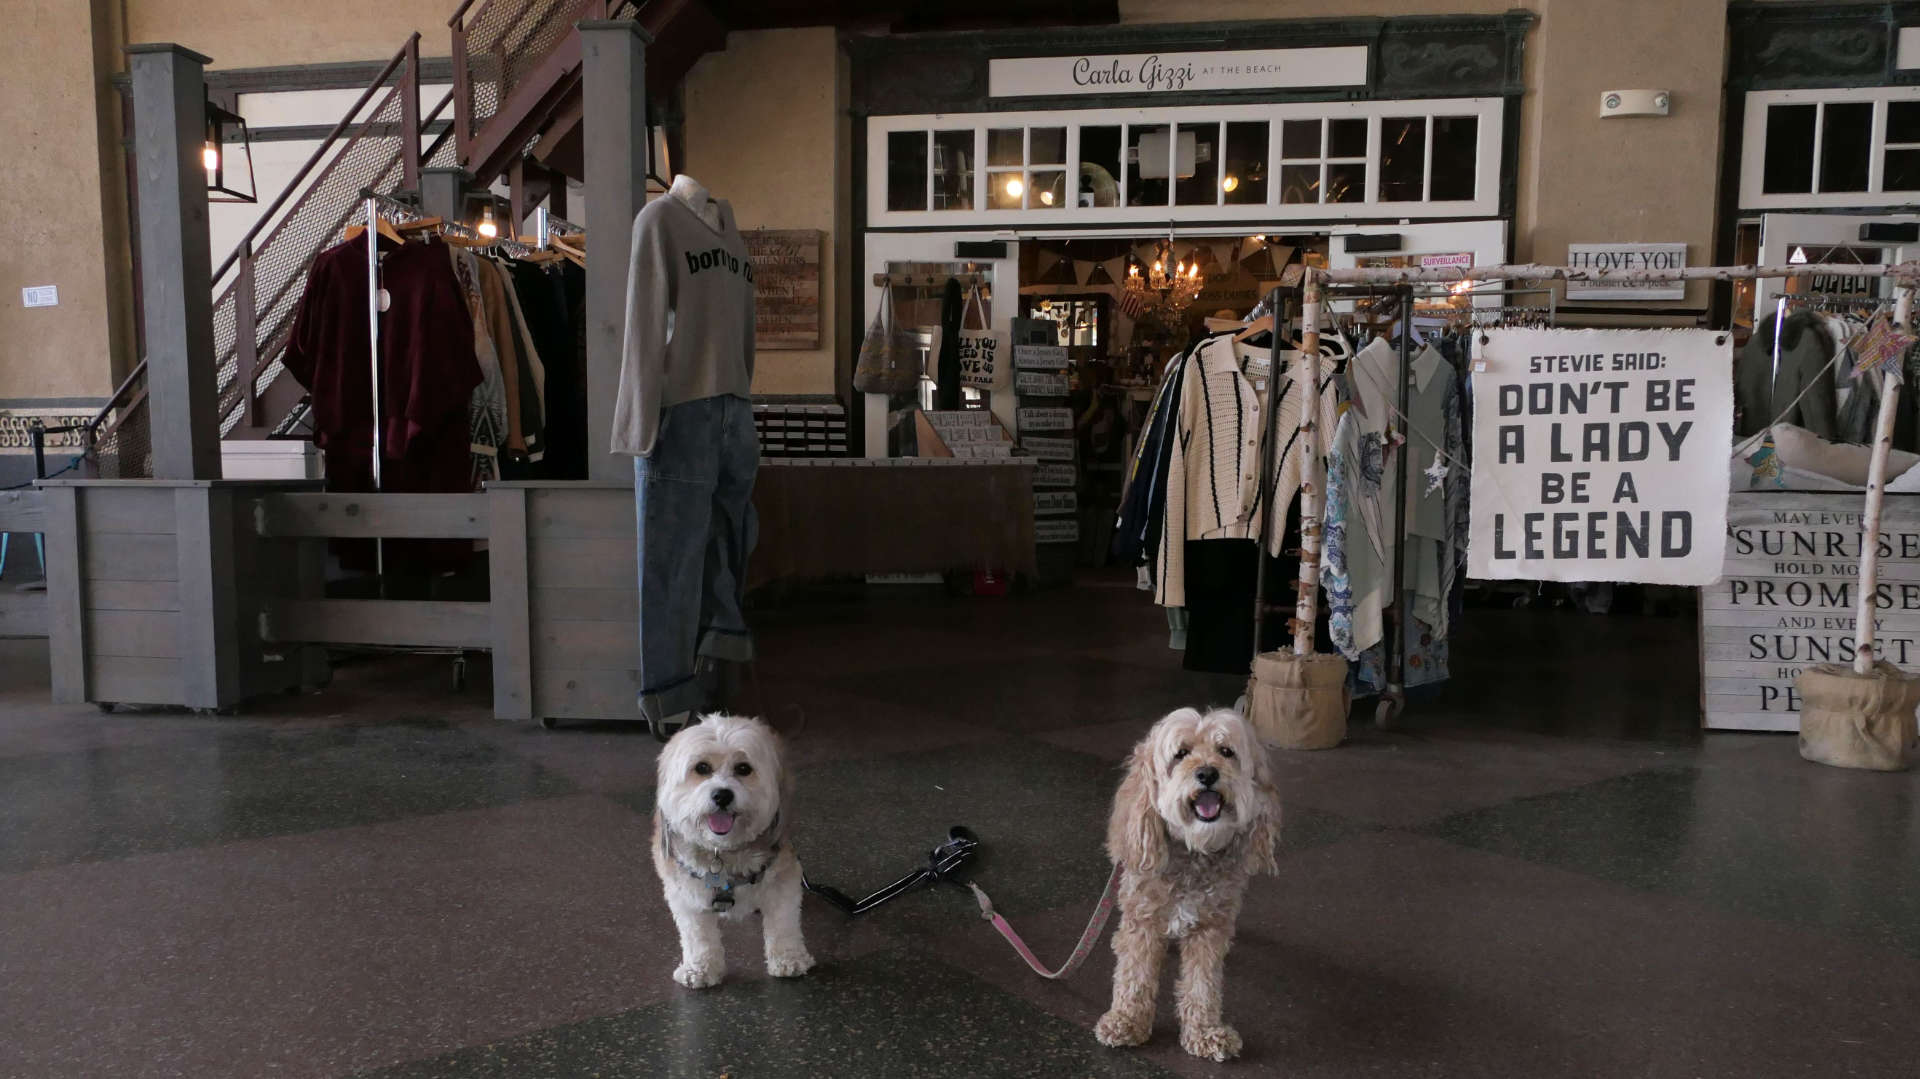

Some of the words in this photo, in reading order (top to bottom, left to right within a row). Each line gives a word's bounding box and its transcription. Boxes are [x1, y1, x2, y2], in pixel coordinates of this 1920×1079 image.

[1073, 58, 1133, 86] Carla
[1139, 55, 1195, 90] Gizzi
[1203, 67, 1214, 75] AT
[1221, 66, 1240, 75] THE
[1246, 64, 1281, 75] BEACH
[1423, 255, 1470, 267] SURVEILLANCE
[1640, 251, 1682, 271] YOU
[744, 261, 752, 283] ru
[960, 337, 972, 348] LL
[975, 337, 997, 350] YOU
[960, 350, 978, 359] EED
[982, 350, 993, 362] IS
[1531, 354, 1604, 374] STEVIE
[1612, 353, 1668, 371] SAID:
[1500, 381, 1629, 416] DON'T
[1647, 379, 1696, 412] BE
[1499, 424, 1525, 465] A
[1551, 421, 1693, 463] LADY
[1541, 472, 1591, 505] BE
[1612, 471, 1638, 504] A
[1774, 512, 1812, 525] MAY
[1821, 513, 1864, 526] EVE
[1494, 510, 1692, 560] LEGEND
[1736, 530, 1920, 559] SUNRISE
[1775, 562, 1825, 575] HOLD
[1831, 564, 1884, 577] MOE
[1729, 580, 1920, 610] PROMSE
[1777, 616, 1816, 629] AND
[1824, 617, 1884, 630] EVEY
[1777, 667, 1802, 678] HO
